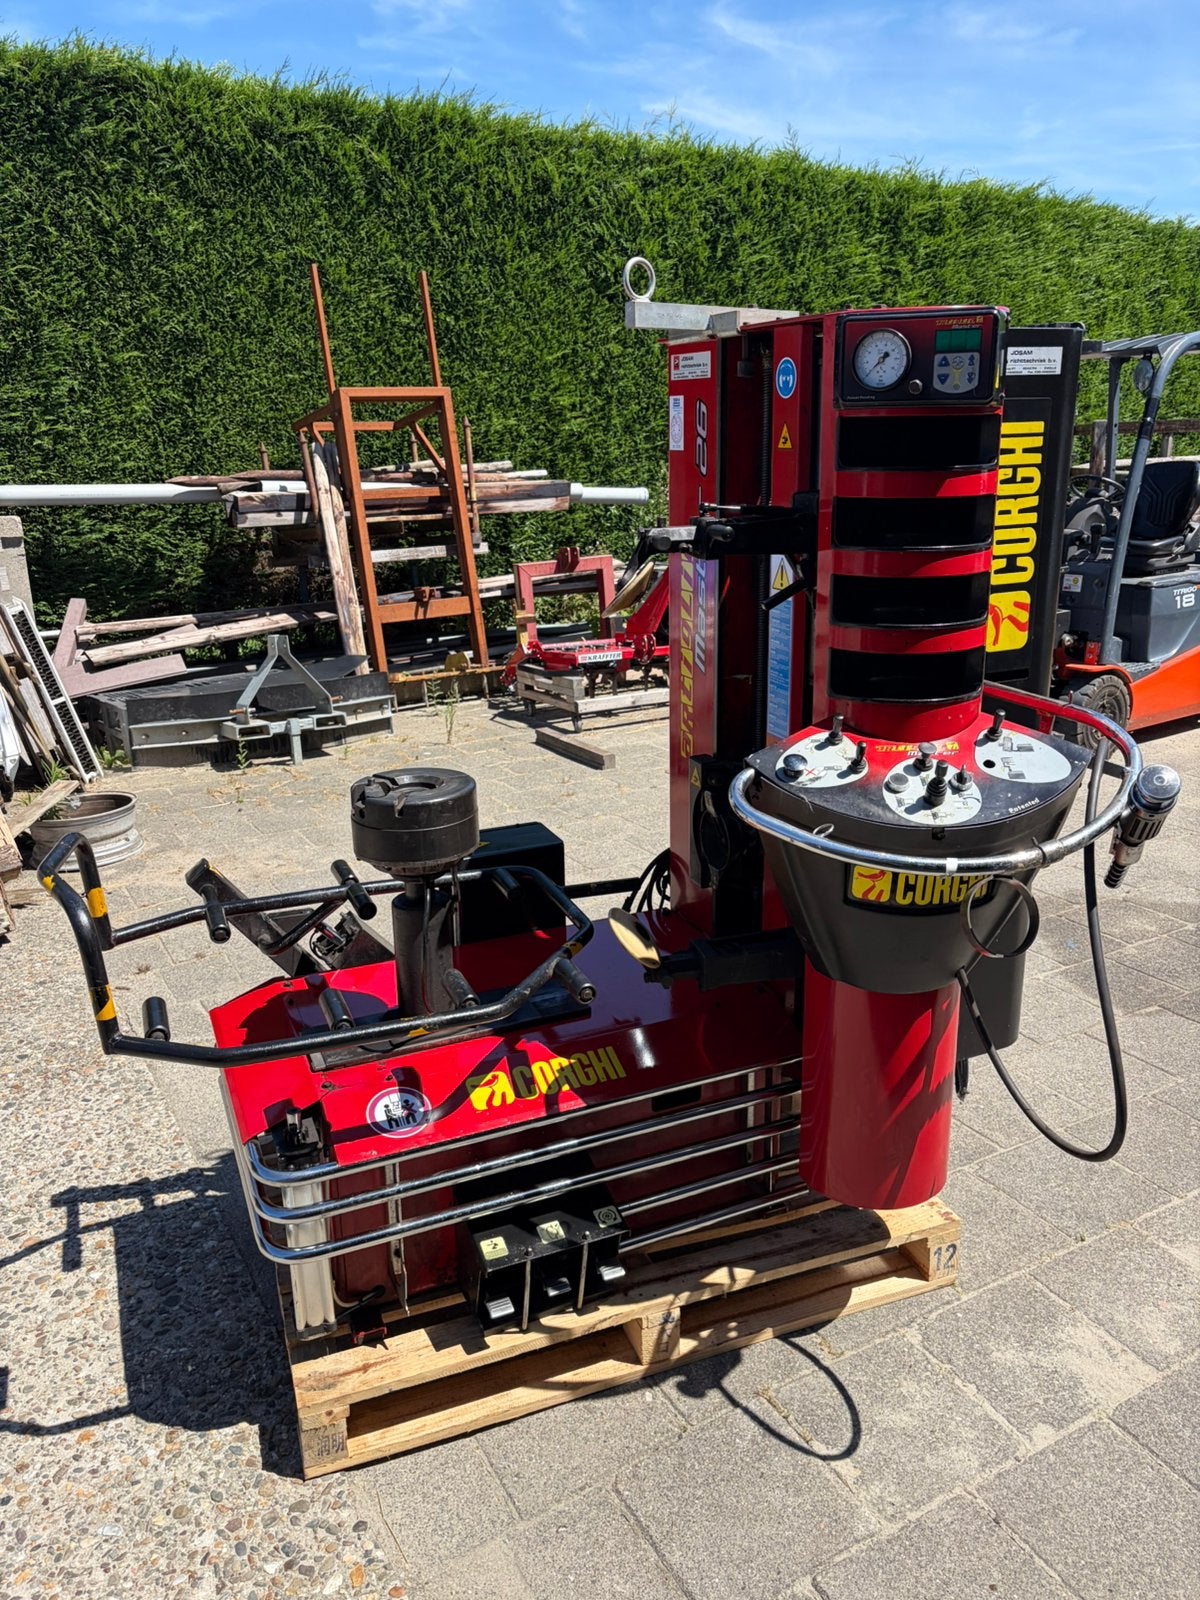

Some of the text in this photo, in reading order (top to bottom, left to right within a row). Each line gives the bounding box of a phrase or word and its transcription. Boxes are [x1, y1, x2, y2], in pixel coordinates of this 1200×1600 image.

[696, 398, 707, 477] 26
[991, 421, 1045, 585] CORGHI
[1175, 593, 1195, 609] 18
[1008, 797, 1040, 813] Patented
[512, 1046, 626, 1100] CORGHI
[934, 1243, 957, 1271] 12
